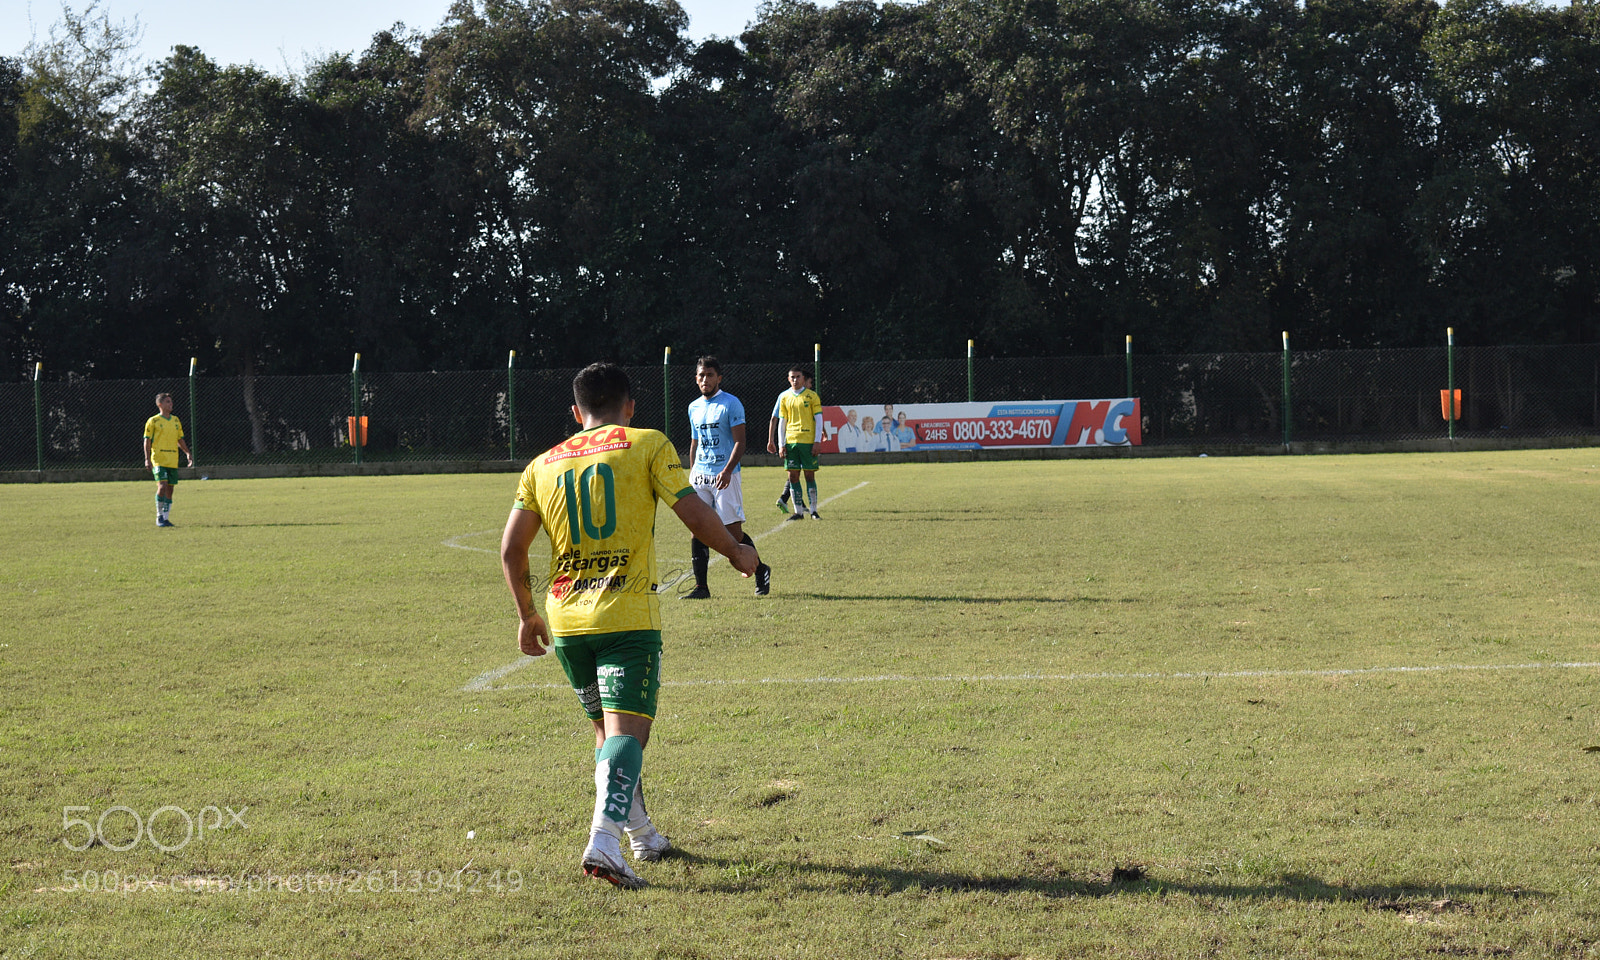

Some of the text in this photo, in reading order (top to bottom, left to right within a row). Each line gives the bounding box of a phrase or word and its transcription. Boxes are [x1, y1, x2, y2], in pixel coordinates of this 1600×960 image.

[925, 428, 948, 441] 24HS
[952, 419, 1052, 441] 0800-333-4670
[547, 442, 629, 463] VIVIENDAS AMERICANAS
[557, 462, 617, 545] 10
[556, 554, 629, 573] recargas
[575, 599, 594, 607] LYON
[641, 653, 652, 700] LYON
